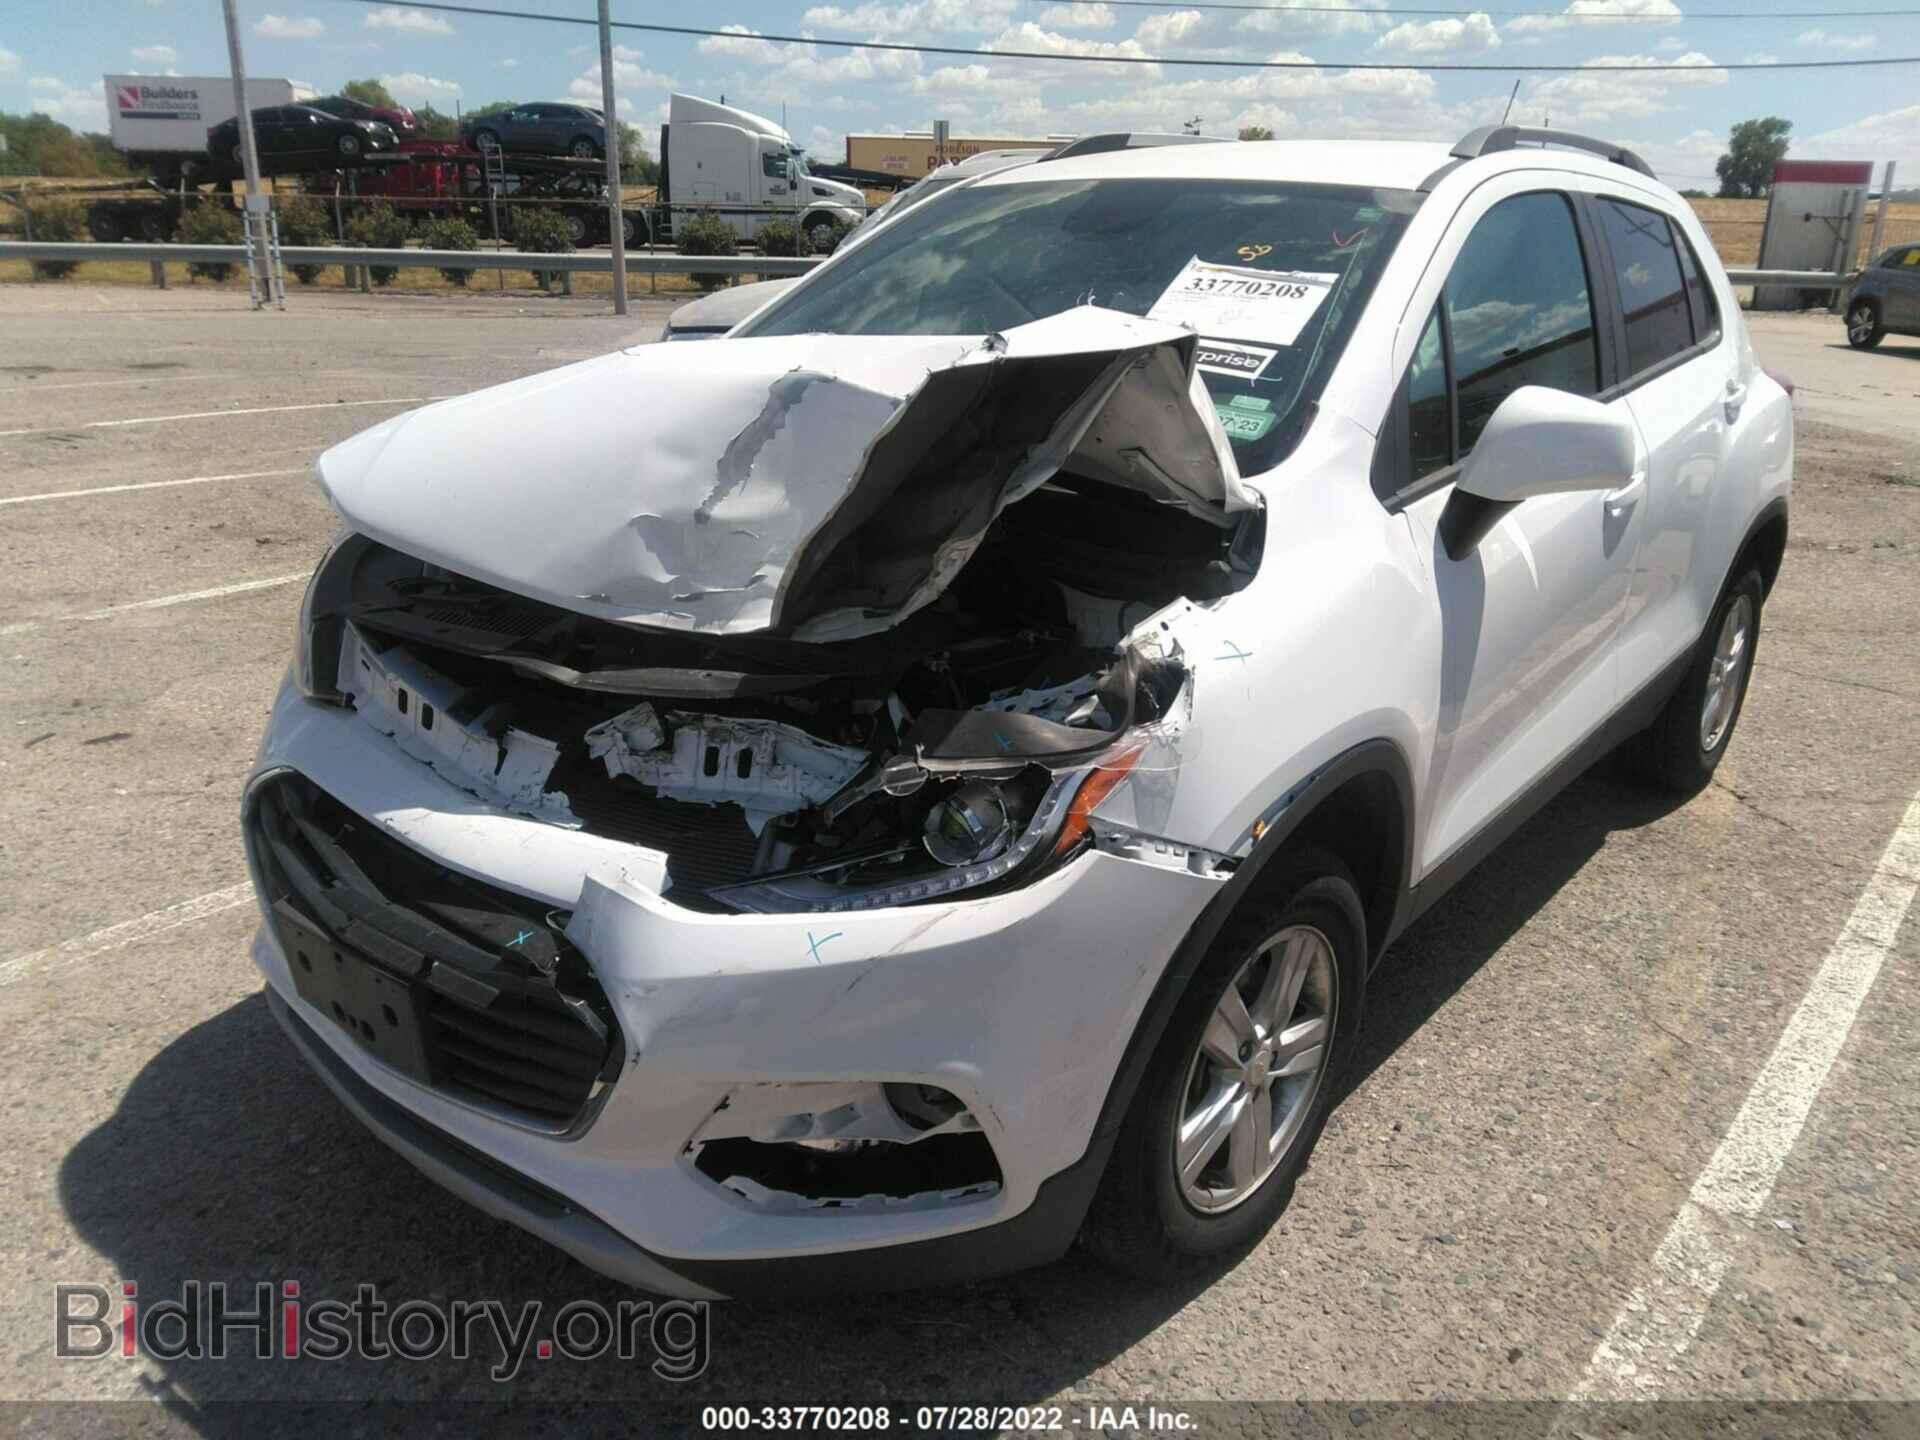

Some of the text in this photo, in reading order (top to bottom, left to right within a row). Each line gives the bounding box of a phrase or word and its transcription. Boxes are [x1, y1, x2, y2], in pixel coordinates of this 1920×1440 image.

[141, 86, 198, 99] Builders
[1184, 277, 1309, 299] 33770208
[1238, 419, 1260, 431] 23
